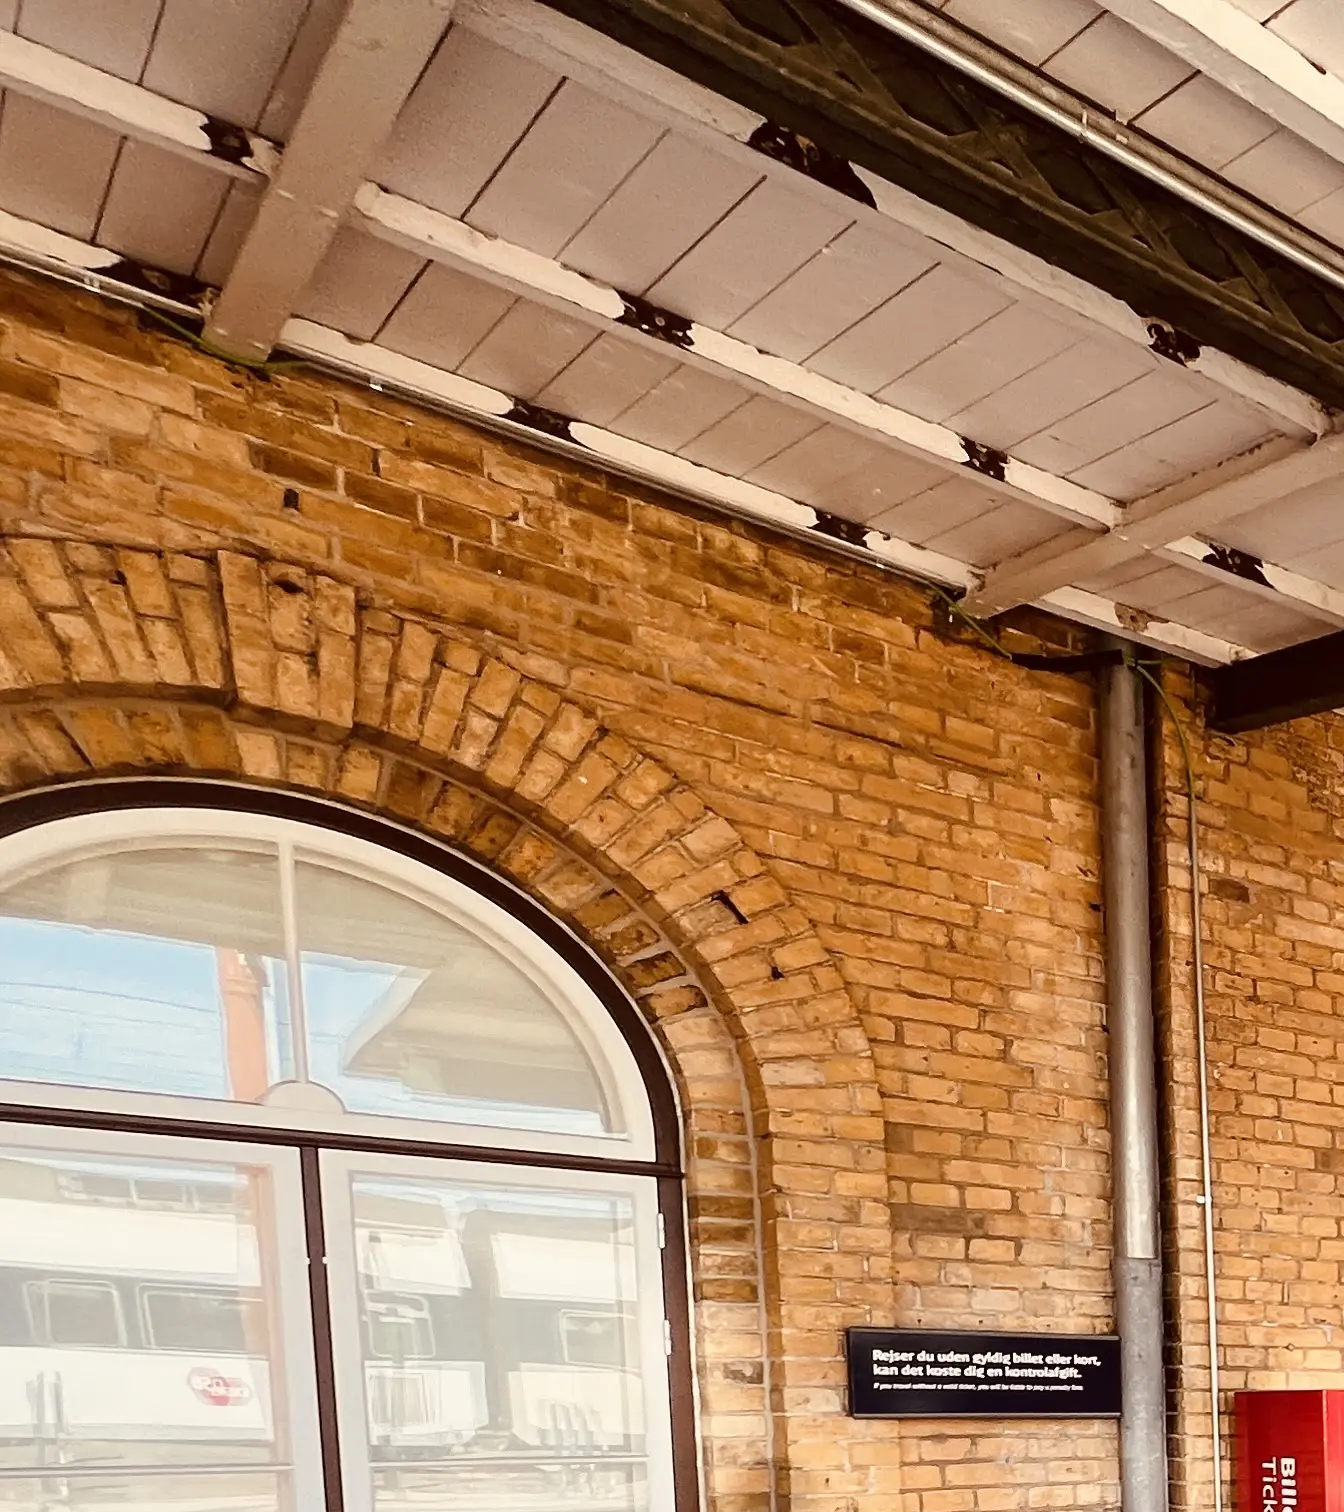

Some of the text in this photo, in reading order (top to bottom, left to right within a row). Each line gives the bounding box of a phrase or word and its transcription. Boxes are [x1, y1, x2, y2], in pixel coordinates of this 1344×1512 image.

[872, 1349, 1102, 1366] Rejser du uden gyldig billet eller kort,
[873, 1364, 1083, 1379] kan det koste dig en kontrolafgift.
